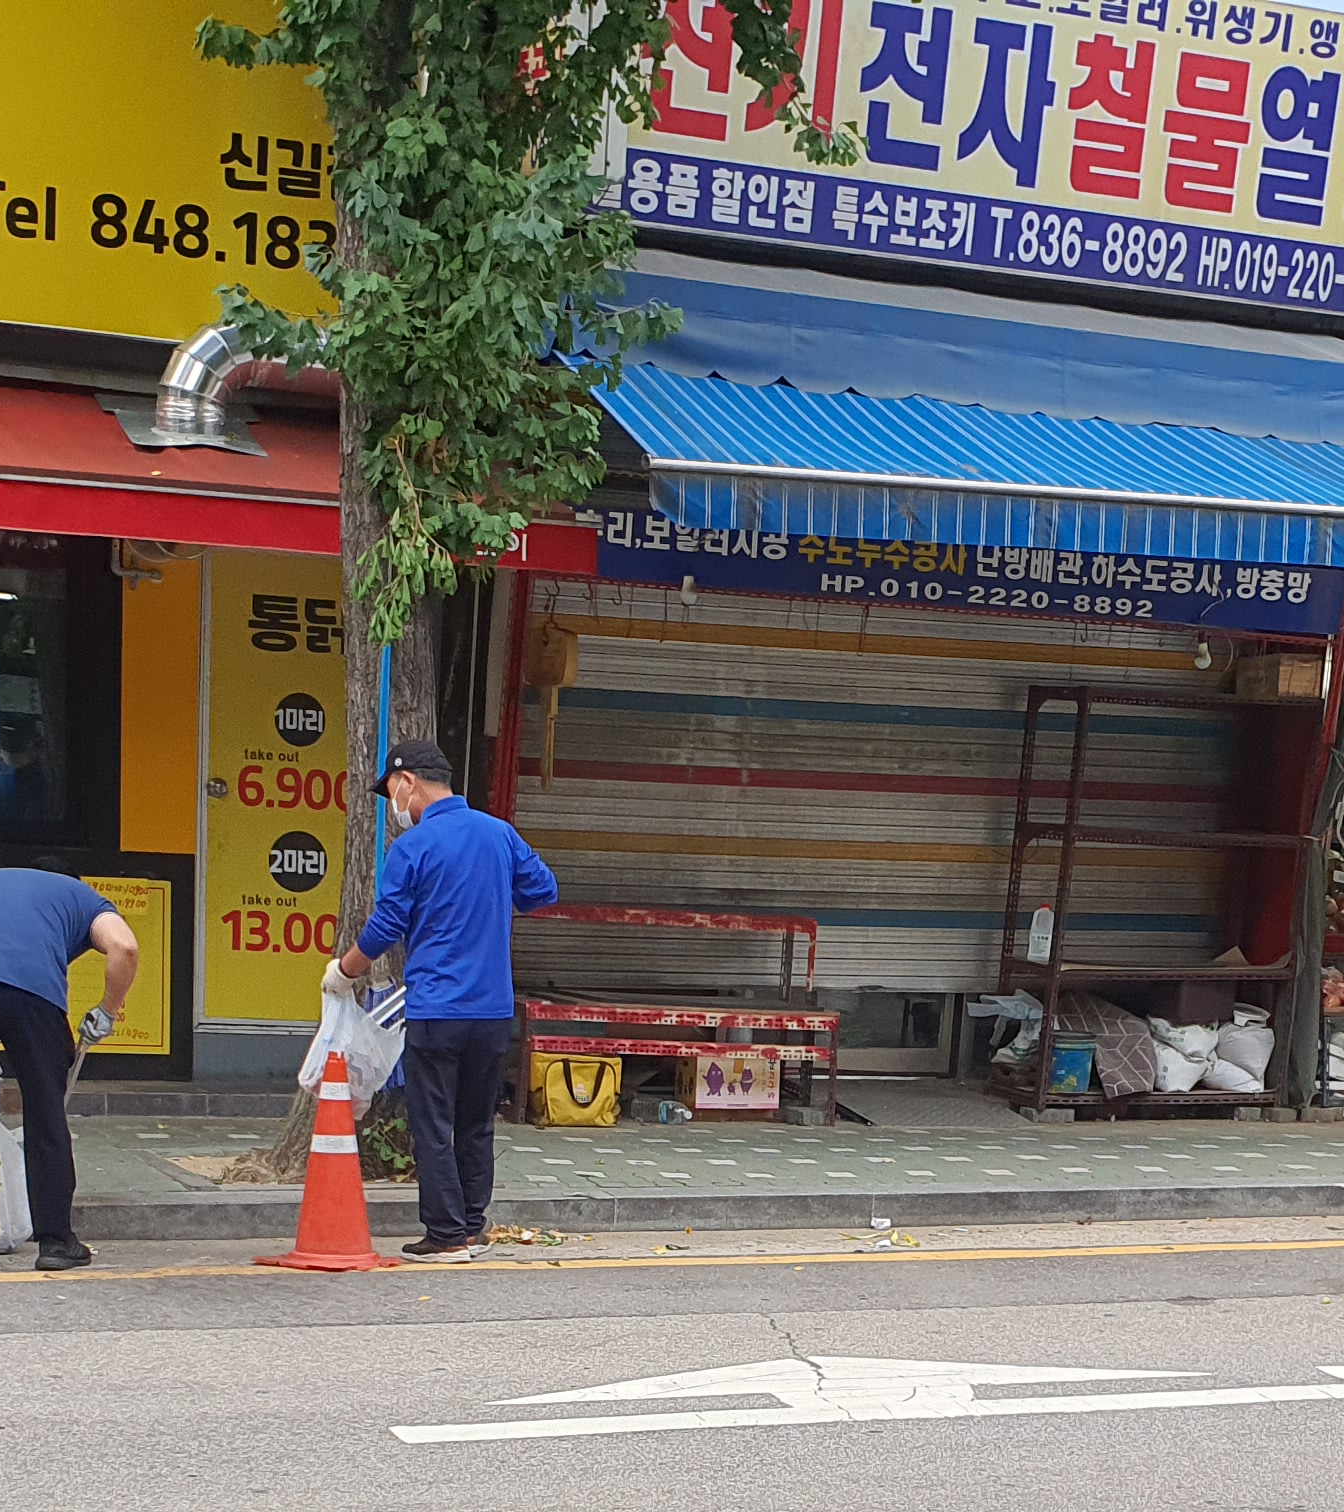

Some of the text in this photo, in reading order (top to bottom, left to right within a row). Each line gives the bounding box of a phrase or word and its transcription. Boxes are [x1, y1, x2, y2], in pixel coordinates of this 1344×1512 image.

[220, 132, 337, 201] 신길
[90, 193, 338, 270] 848.183
[711, 168, 816, 234] 할인점
[831, 185, 976, 257] 특수보조키
[990, 207, 1189, 283] T.836-8892
[597, 511, 789, 560] 리,보일러시공
[820, 573, 1154, 619] HP.010-2220-8892
[248, 593, 345, 656] 통닭
[274, 707, 325, 733] 1마리
[244, 748, 300, 763] take out
[269, 848, 326, 875] 2마리
[242, 893, 297, 908] take out
[221, 910, 337, 955] 13.00
